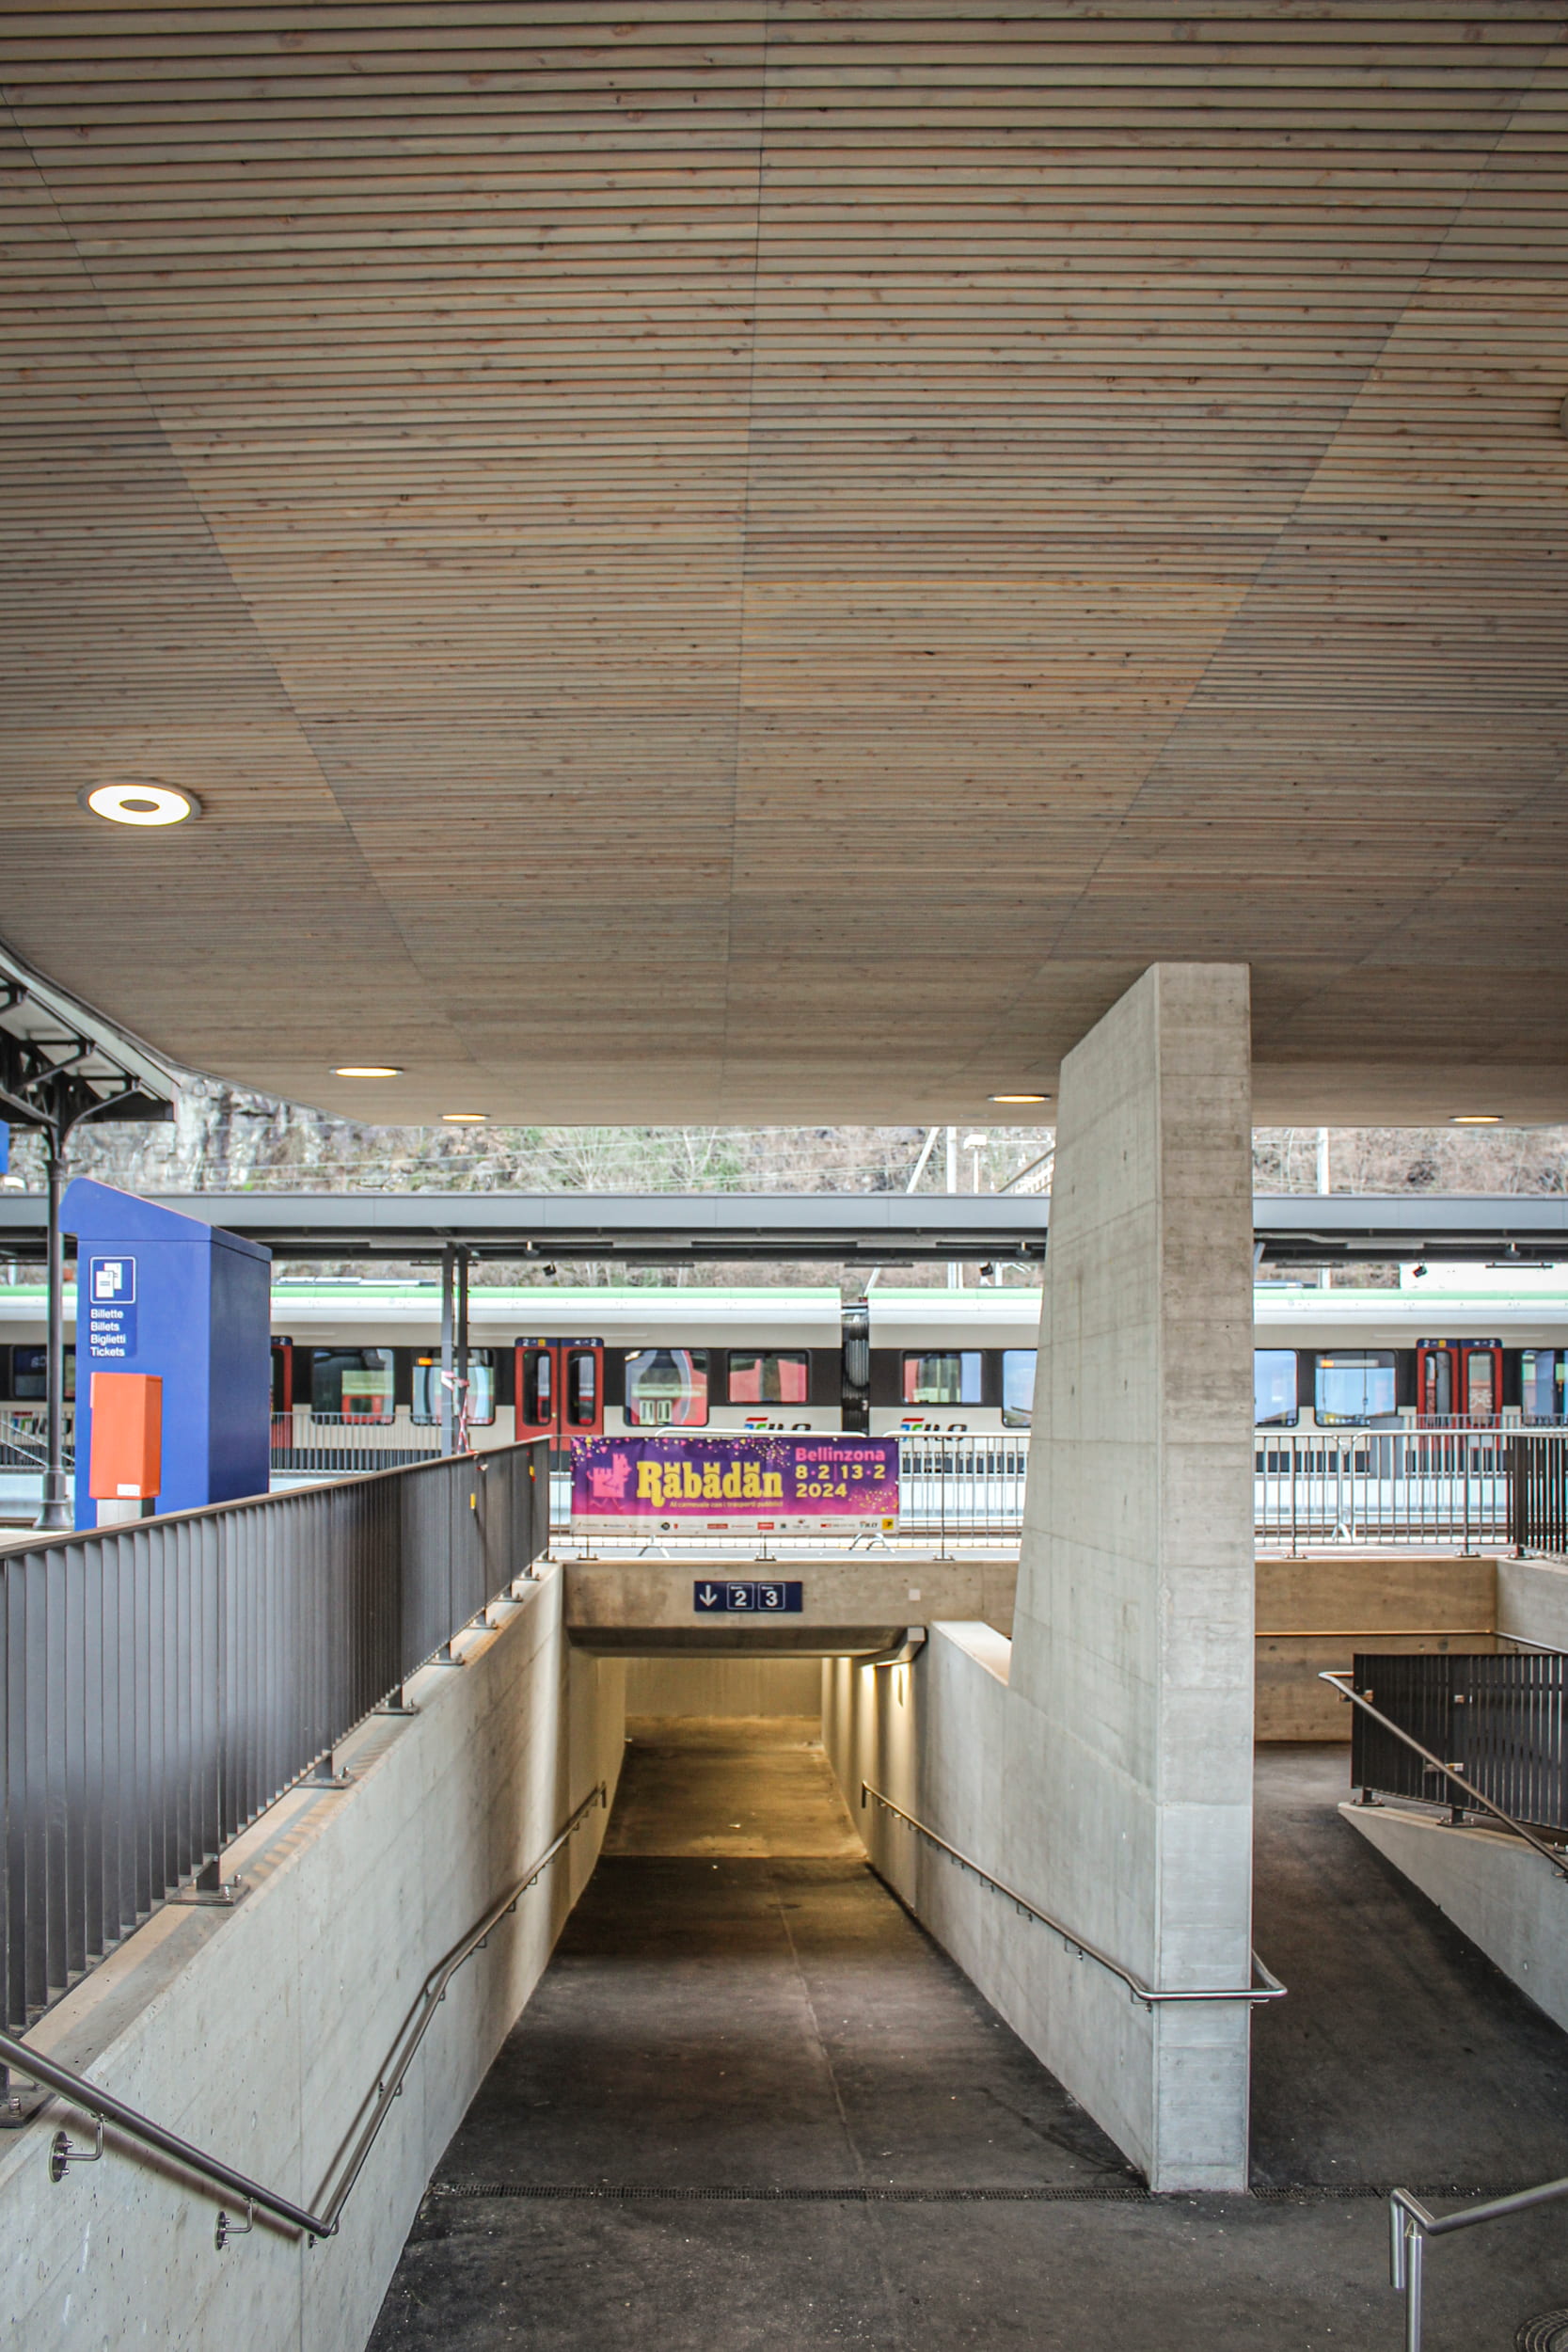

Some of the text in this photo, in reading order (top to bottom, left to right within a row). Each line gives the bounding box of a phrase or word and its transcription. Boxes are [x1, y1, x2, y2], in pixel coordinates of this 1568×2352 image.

[90, 1309, 124, 1319] Billette
[90, 1322, 120, 1332] Billets
[90, 1334, 126, 1346] Biglietti
[522, 1338, 529, 1347] 2
[591, 1338, 597, 1347] 2
[90, 1346, 125, 1357] Tickets
[795, 1447, 886, 1462] Bellinzona
[796, 1483, 847, 1498] 2024
[735, 1590, 778, 1607] 2 3
